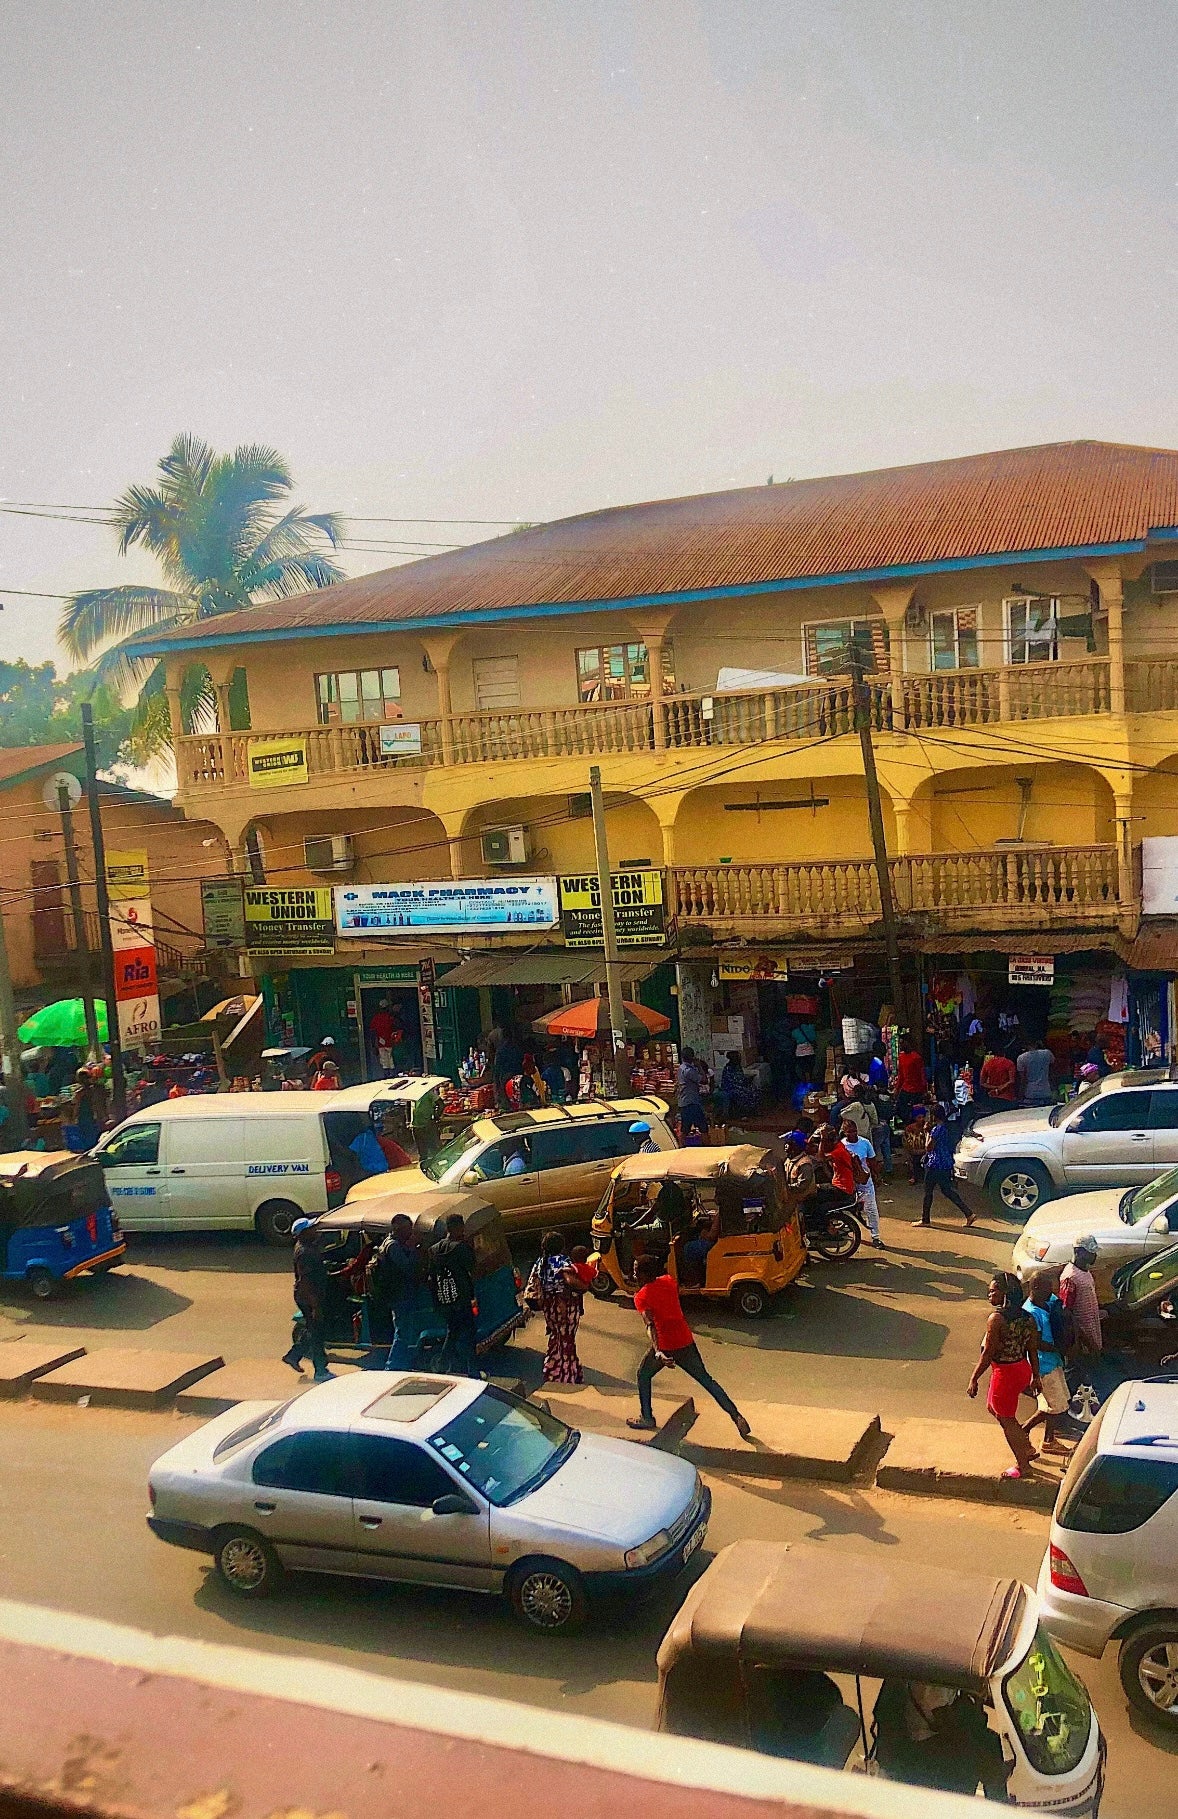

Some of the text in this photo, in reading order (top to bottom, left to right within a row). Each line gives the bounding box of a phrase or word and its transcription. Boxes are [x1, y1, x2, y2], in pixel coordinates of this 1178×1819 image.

[563, 873, 642, 893] WESERN
[246, 891, 315, 905] WESTERN
[372, 886, 530, 898] MACK PHARMACY
[591, 889, 643, 906] UION
[270, 905, 316, 919] UNION
[571, 911, 602, 921] Mone
[252, 922, 326, 933] Money Transfer
[124, 957, 150, 982] Ria
[721, 964, 750, 974] NIDO
[126, 1020, 158, 1036] AFRO
[248, 1163, 310, 1174] DELIVERY VAN
